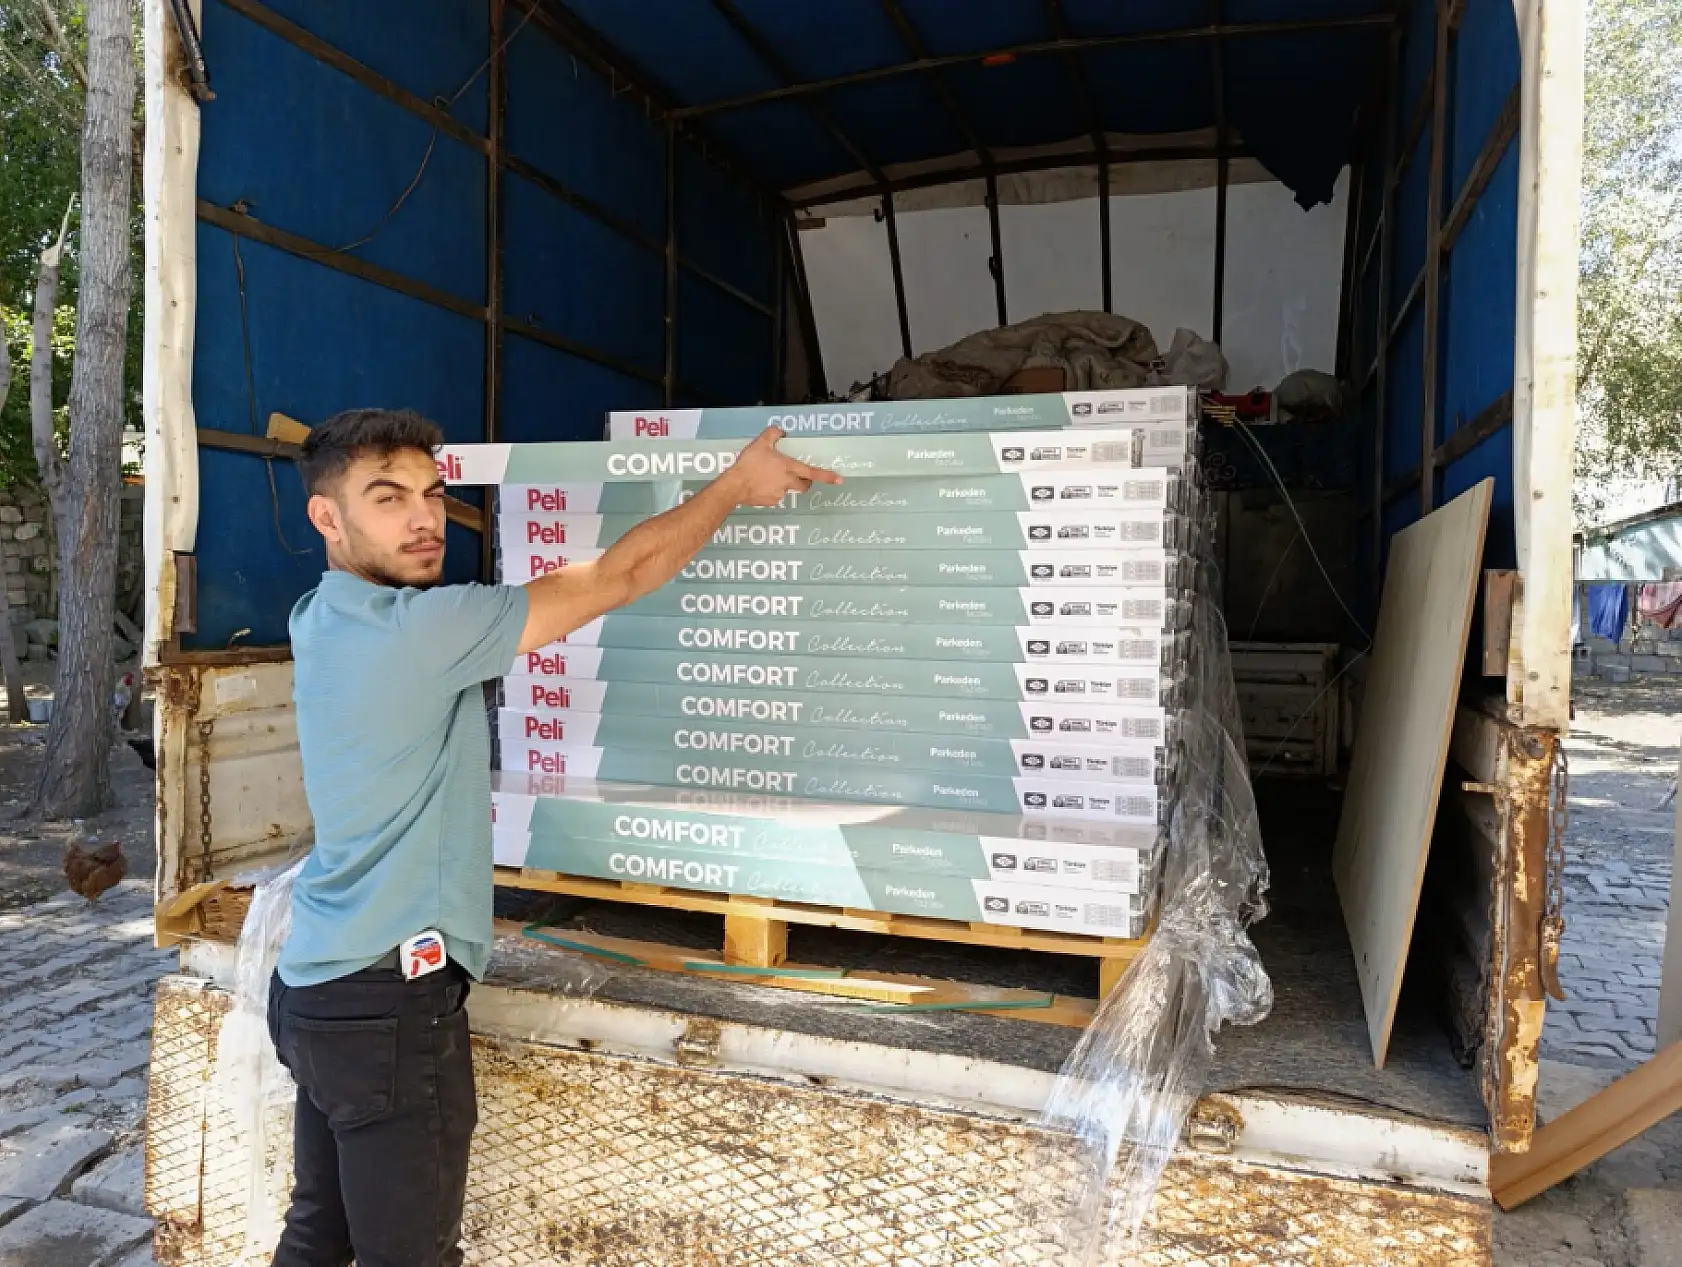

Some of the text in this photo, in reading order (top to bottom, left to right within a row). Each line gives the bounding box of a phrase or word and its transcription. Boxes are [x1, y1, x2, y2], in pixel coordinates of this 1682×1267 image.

[635, 416, 669, 437] Peli
[435, 453, 463, 480] eli
[607, 451, 740, 475] COMFOR
[527, 488, 566, 511] Peli
[809, 490, 908, 509] Collection
[527, 520, 566, 544] Peli
[713, 524, 907, 546] MFORT Collection
[681, 559, 908, 581] COMFORT Collection
[680, 593, 908, 618] COMFORT Collection
[678, 627, 905, 653] COMFORT Collection
[527, 652, 566, 675] Peli
[676, 661, 904, 690] COMFORT Collection
[532, 685, 570, 708] Peli
[681, 695, 907, 727] COMFORT Collection
[525, 716, 563, 740] Peli
[674, 729, 900, 762] COMFORT Collection
[528, 749, 565, 774] Peli
[676, 764, 904, 800] COMFORT Collection
[614, 815, 745, 848] COMFORT
[608, 852, 740, 888] COMFORT
